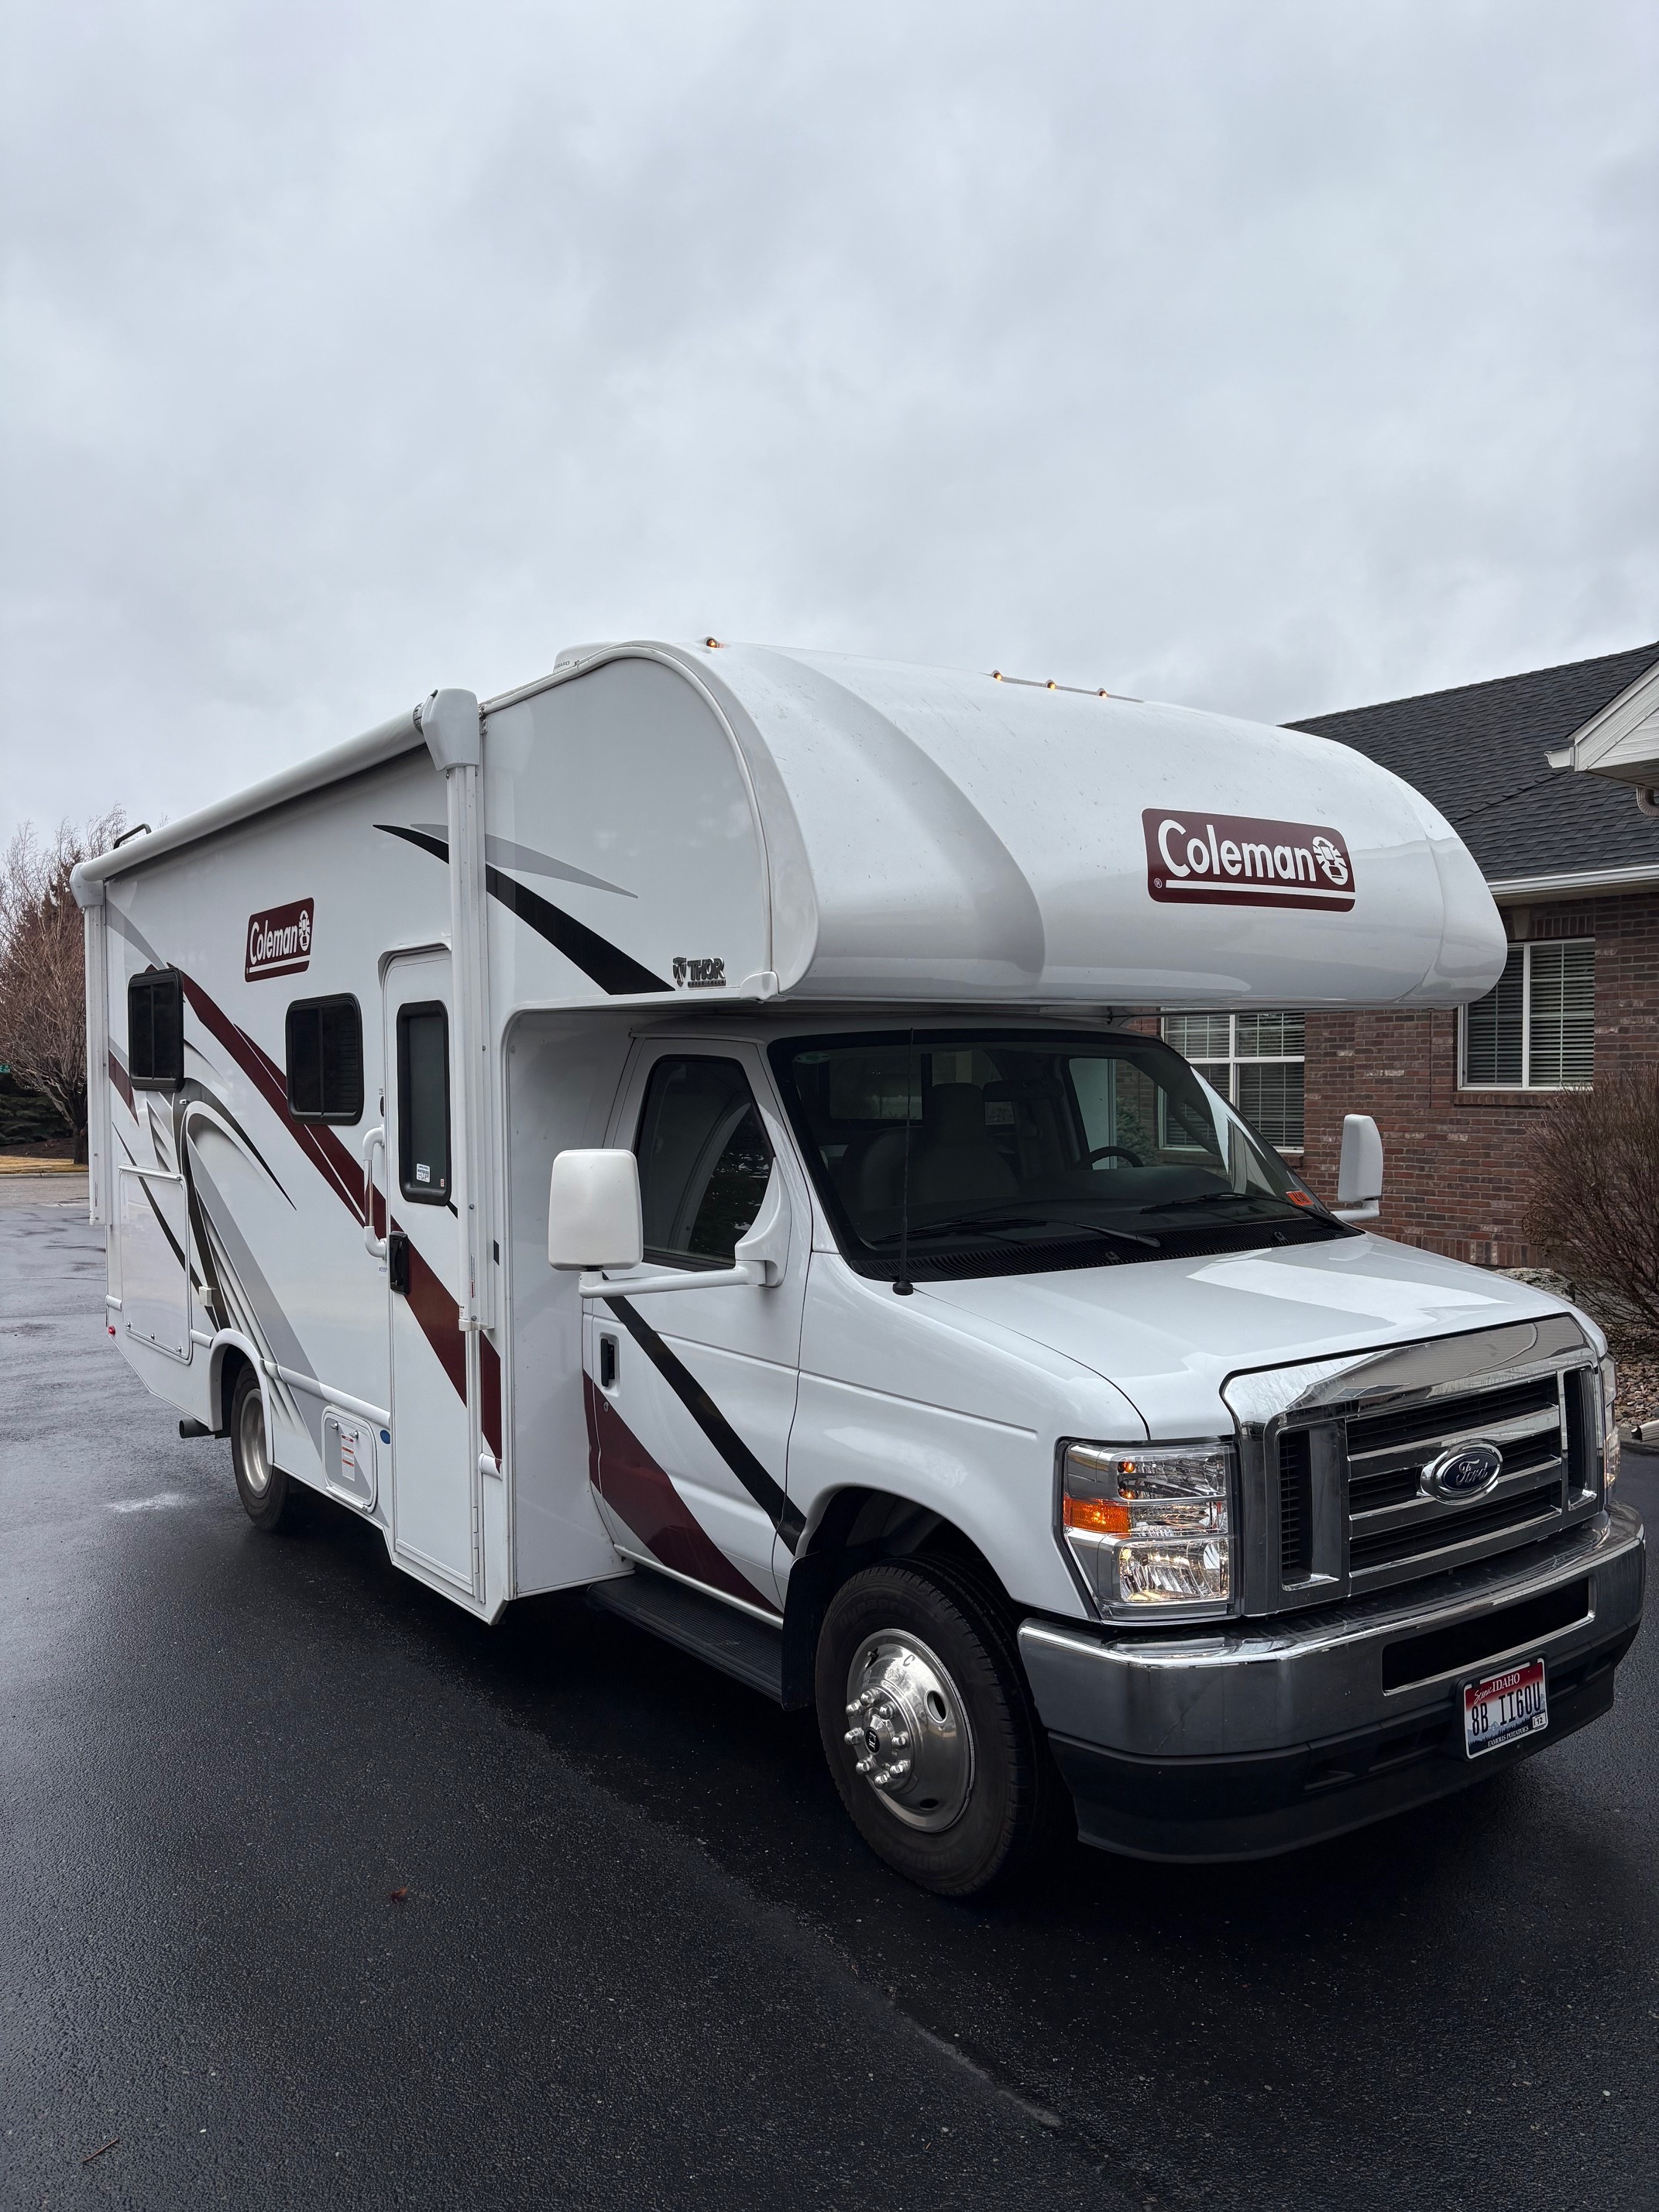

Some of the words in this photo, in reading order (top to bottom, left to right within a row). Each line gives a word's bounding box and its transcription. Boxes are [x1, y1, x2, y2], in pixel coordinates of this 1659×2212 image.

[1158, 819, 1317, 881] Coleman
[249, 919, 298, 965] Coleman
[687, 957, 726, 981] THOR
[1456, 1458, 1489, 1486] Ford
[1474, 1685, 1493, 1704] Scenic
[1492, 1673, 1520, 1692] IDAHO
[1472, 1702, 1489, 1736] 8B
[1537, 1716, 1544, 1725] 12
[1488, 1735, 1506, 1747] FAMOUS
[1506, 1725, 1529, 1740] POTATOES
